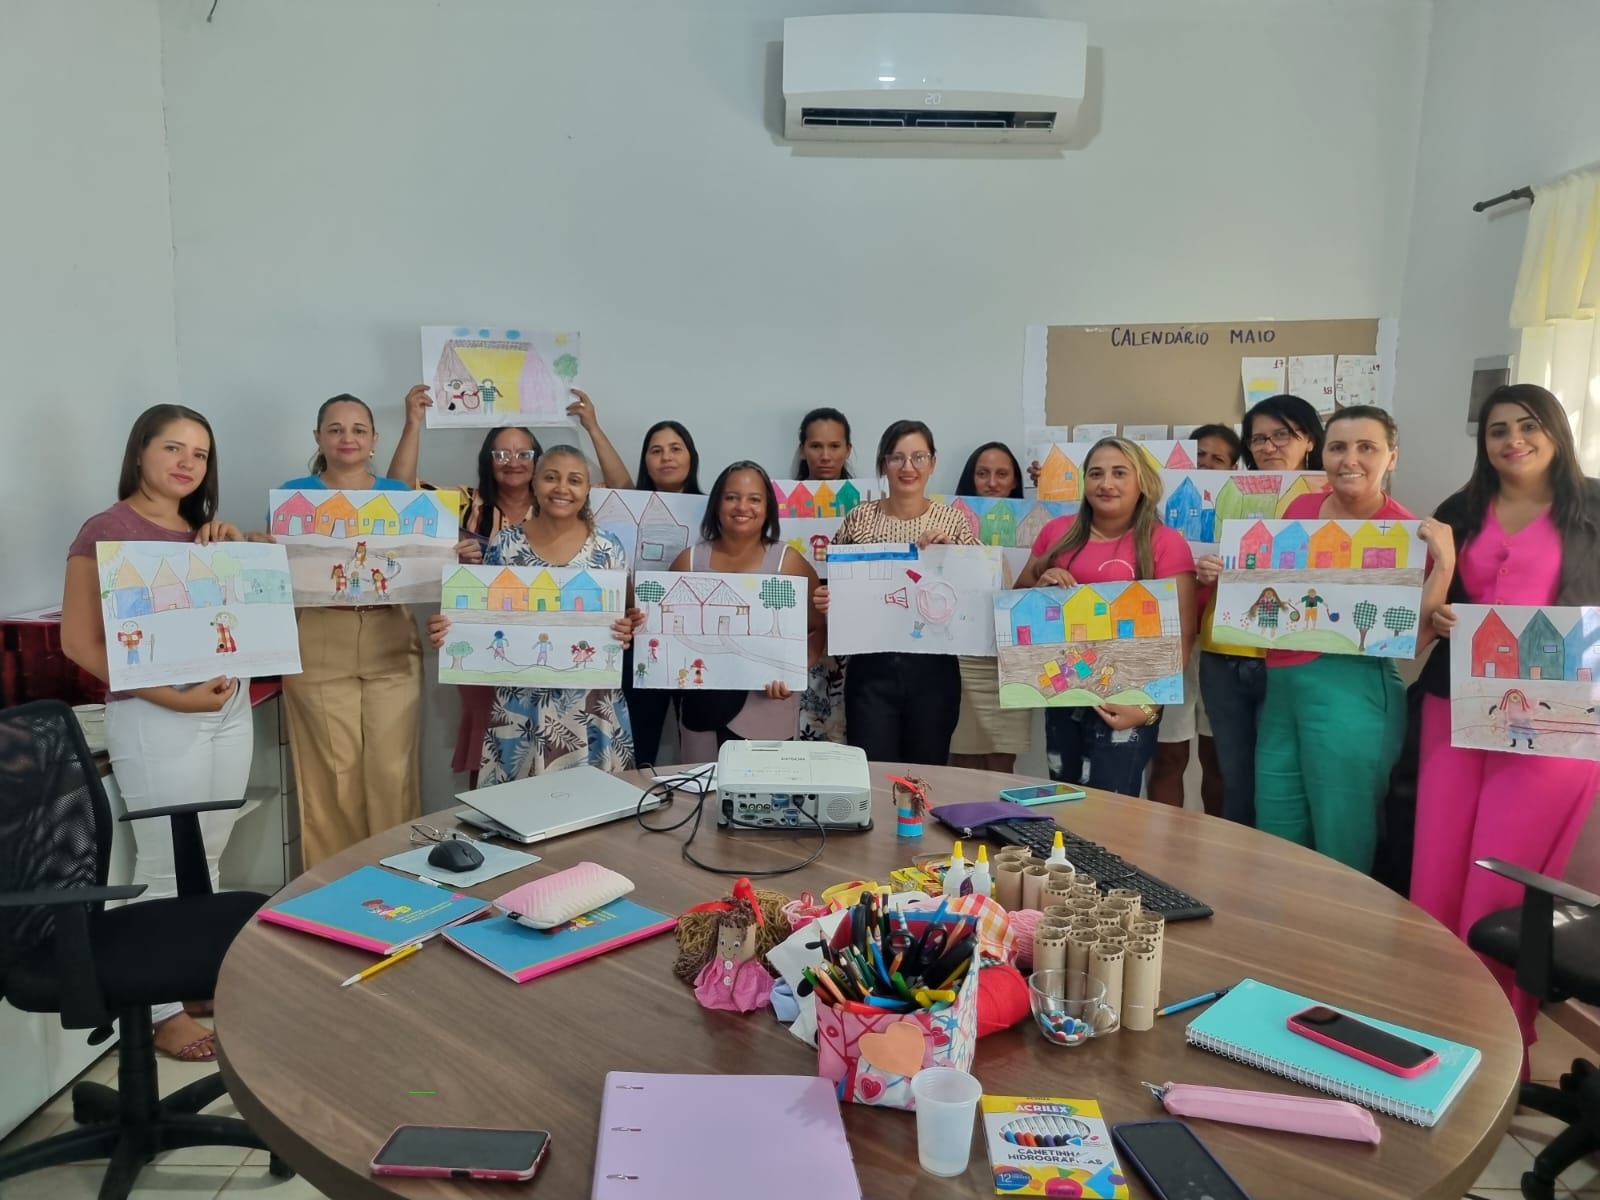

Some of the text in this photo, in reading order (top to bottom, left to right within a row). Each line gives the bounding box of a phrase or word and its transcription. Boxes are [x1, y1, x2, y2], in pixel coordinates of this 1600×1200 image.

[925, 93, 941, 105] 20
[1111, 326, 1276, 347] CALENDÁRIO MAIO
[1272, 359, 1284, 369] 17
[1016, 1104, 1069, 1114] ACRILEX
[1018, 1148, 1081, 1157] CANETINH
[1008, 1153, 1103, 1165] HIDROGRAFAS
[998, 1174, 1012, 1183] 12
